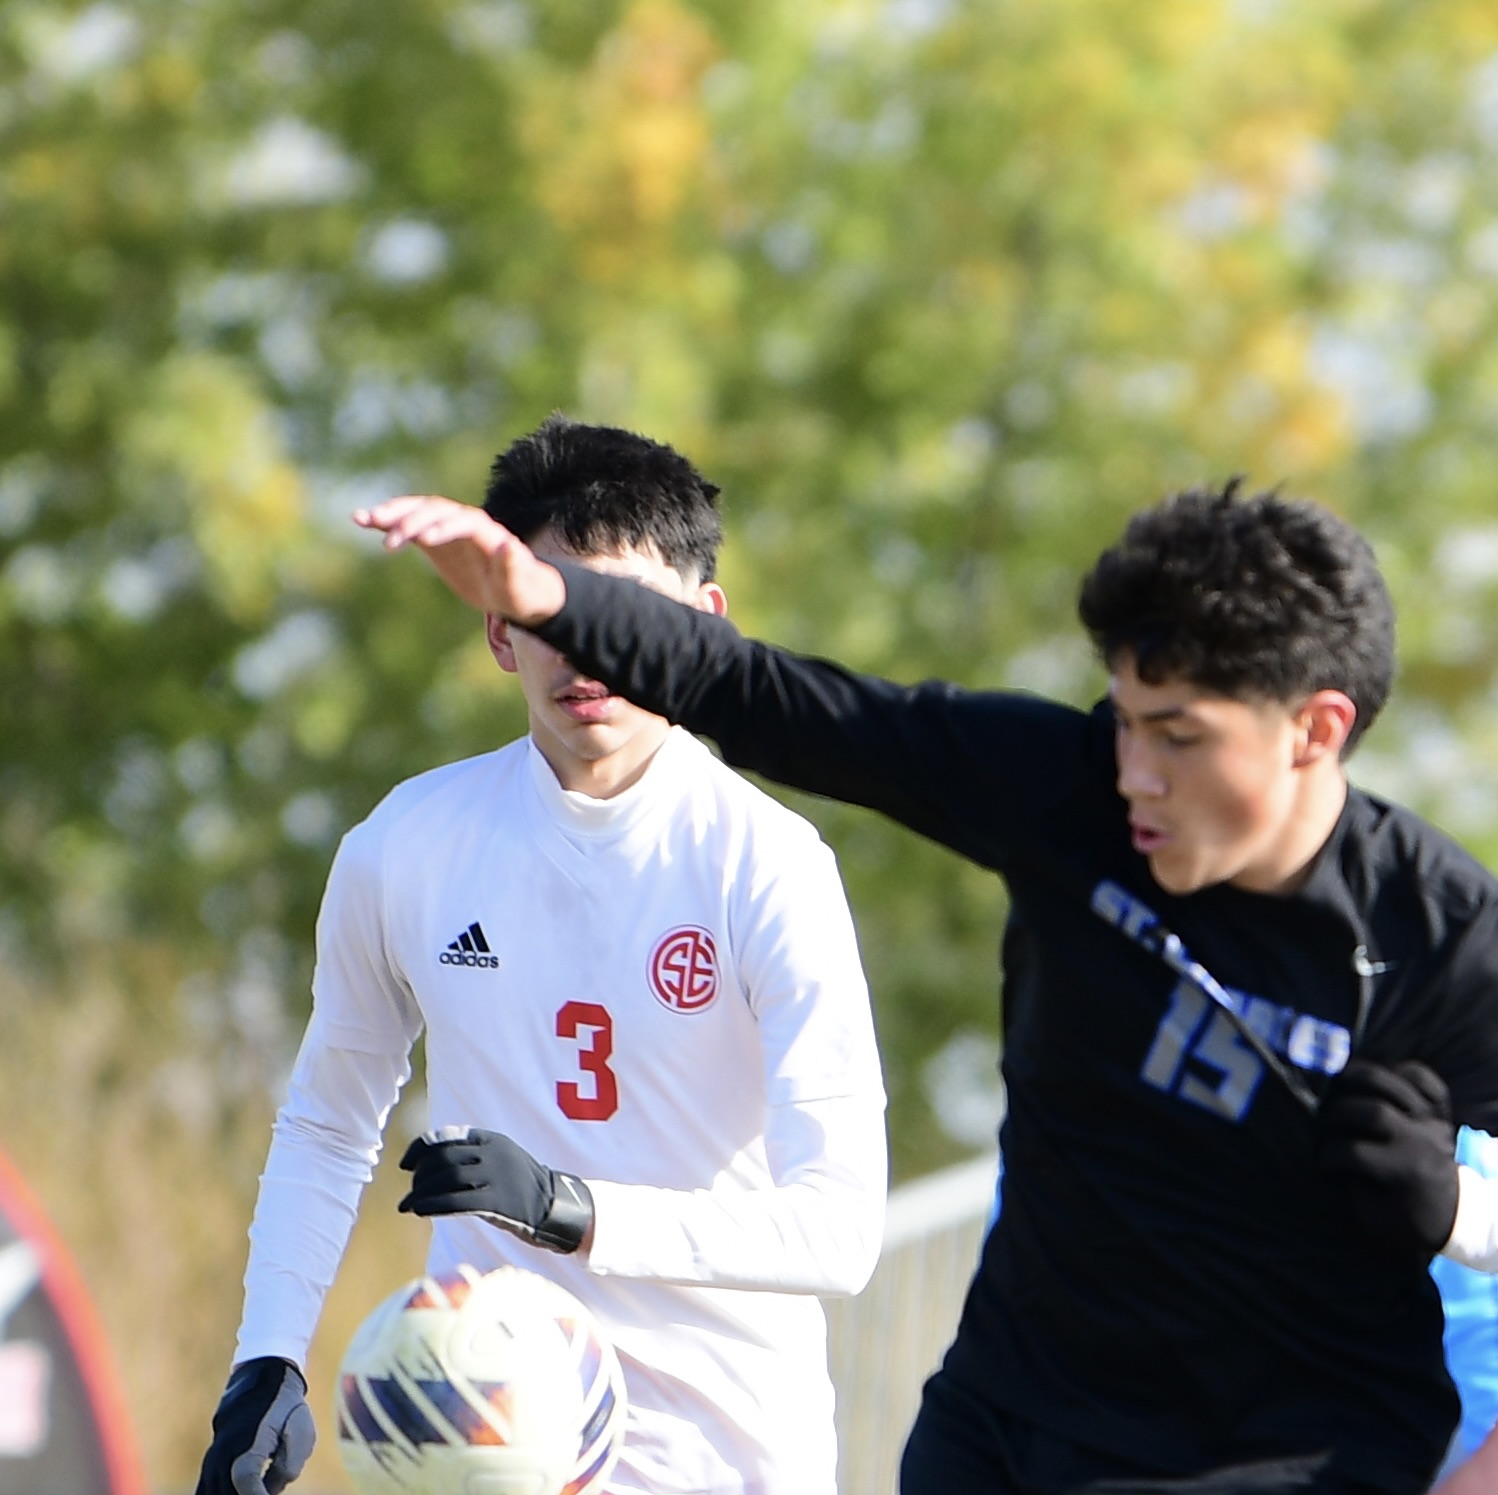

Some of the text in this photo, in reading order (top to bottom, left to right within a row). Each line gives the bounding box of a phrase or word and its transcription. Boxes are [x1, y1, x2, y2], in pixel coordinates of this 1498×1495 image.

[439, 949, 499, 969] adidas
[556, 1001, 618, 1121] 3
[1139, 976, 1265, 1124] 15
